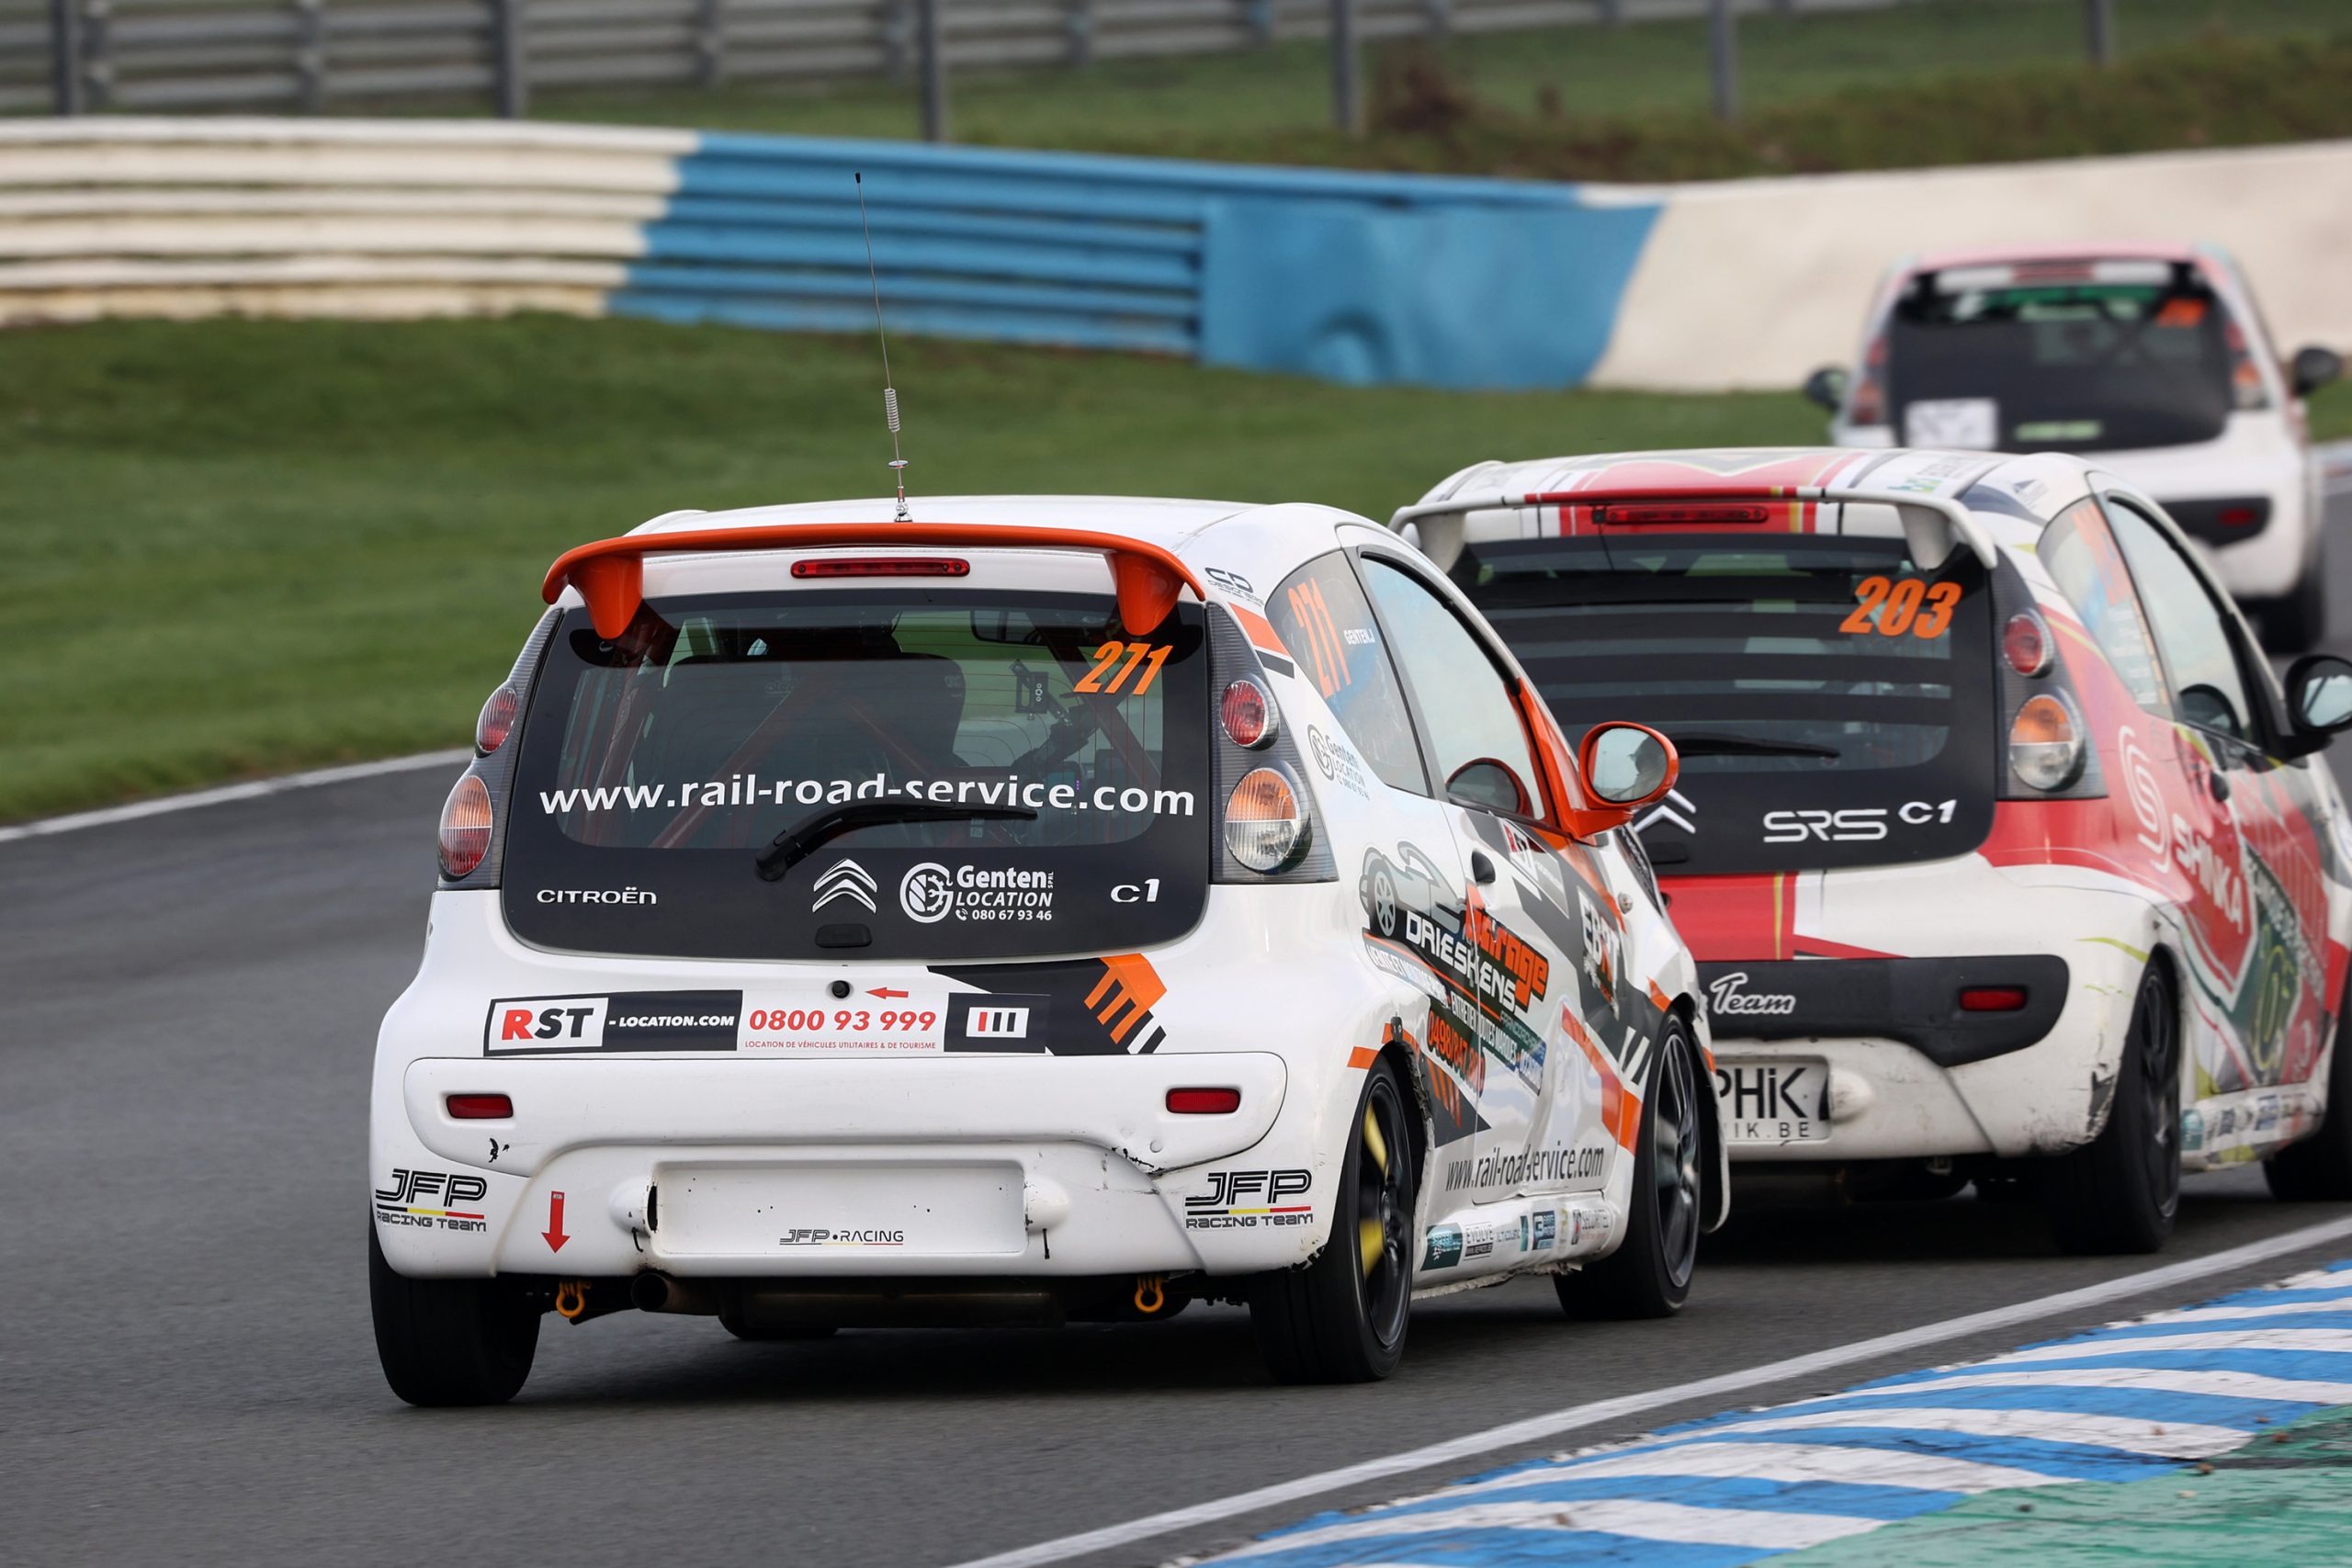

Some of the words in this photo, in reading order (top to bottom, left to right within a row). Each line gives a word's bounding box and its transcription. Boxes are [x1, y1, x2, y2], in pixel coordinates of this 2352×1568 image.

[1839, 576, 1962, 638] 203
[1288, 577, 1351, 699] 271
[1073, 640, 1173, 695] 271
[539, 773, 1194, 815] www.rail-road-service.com
[1763, 809, 1887, 842] SRS
[1898, 799, 1957, 823] C1
[956, 865, 1046, 888] Genten
[956, 891, 1053, 907] LOCATION
[972, 909, 995, 920] 080
[999, 909, 1014, 920] 67
[1017, 909, 1033, 920] 93
[1035, 909, 1052, 921] 46
[1710, 972, 1796, 1014] Team
[502, 1008, 594, 1040] RST
[749, 1010, 825, 1031] 0800
[833, 1010, 871, 1031] 93
[879, 1010, 936, 1032] 999
[798, 1039, 837, 1049] VÉHICULES
[838, 1041, 878, 1049] UTILITAIRES
[375, 1168, 488, 1208] JFP
[1185, 1168, 1313, 1207] JFP
